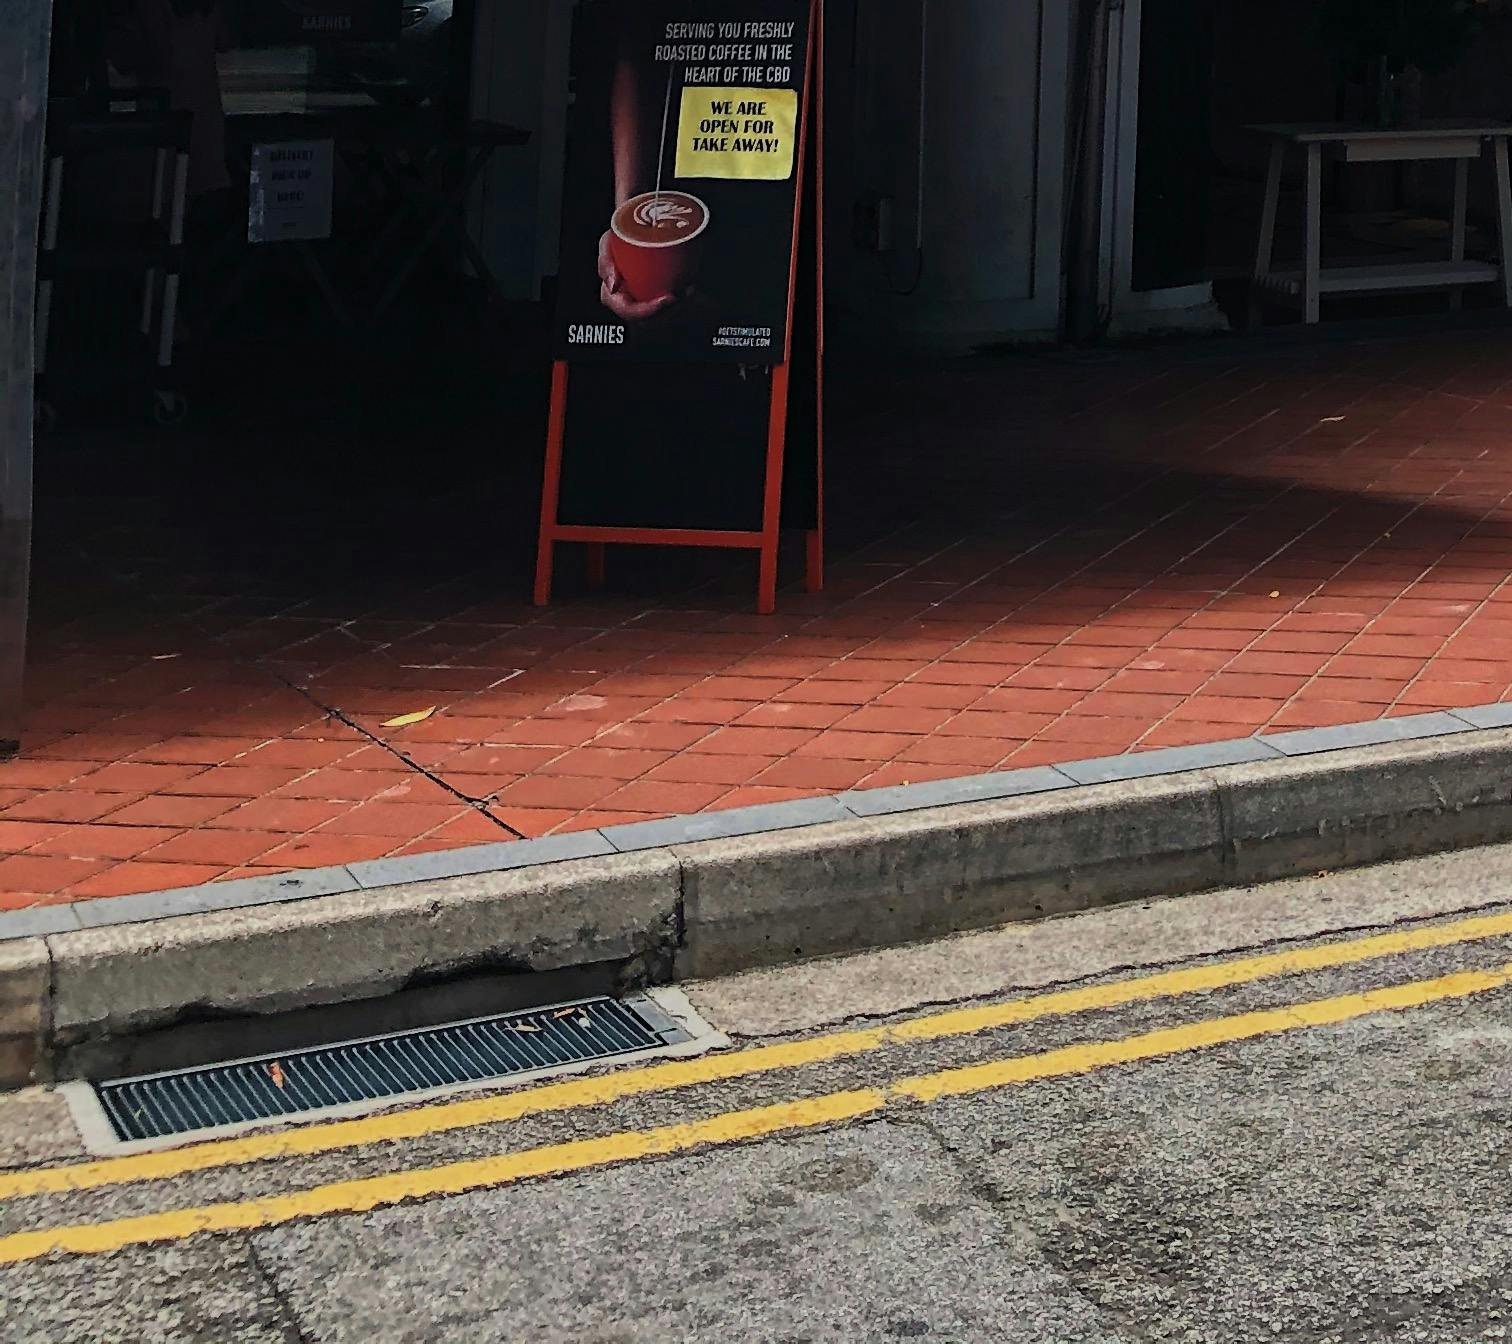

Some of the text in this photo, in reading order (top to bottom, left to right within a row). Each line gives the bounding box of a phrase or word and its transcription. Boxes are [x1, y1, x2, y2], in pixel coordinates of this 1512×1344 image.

[665, 22, 795, 39] SERVING YOU FRESHLY
[654, 44, 793, 61] ROASTED COFFEE IN THE
[684, 66, 791, 83] HEART OF THE CBD
[711, 101, 767, 116] WE ARE
[699, 119, 774, 134] OPEN FOR
[692, 137, 779, 153] TAKE AWAY!
[567, 324, 625, 345] SARNIES
